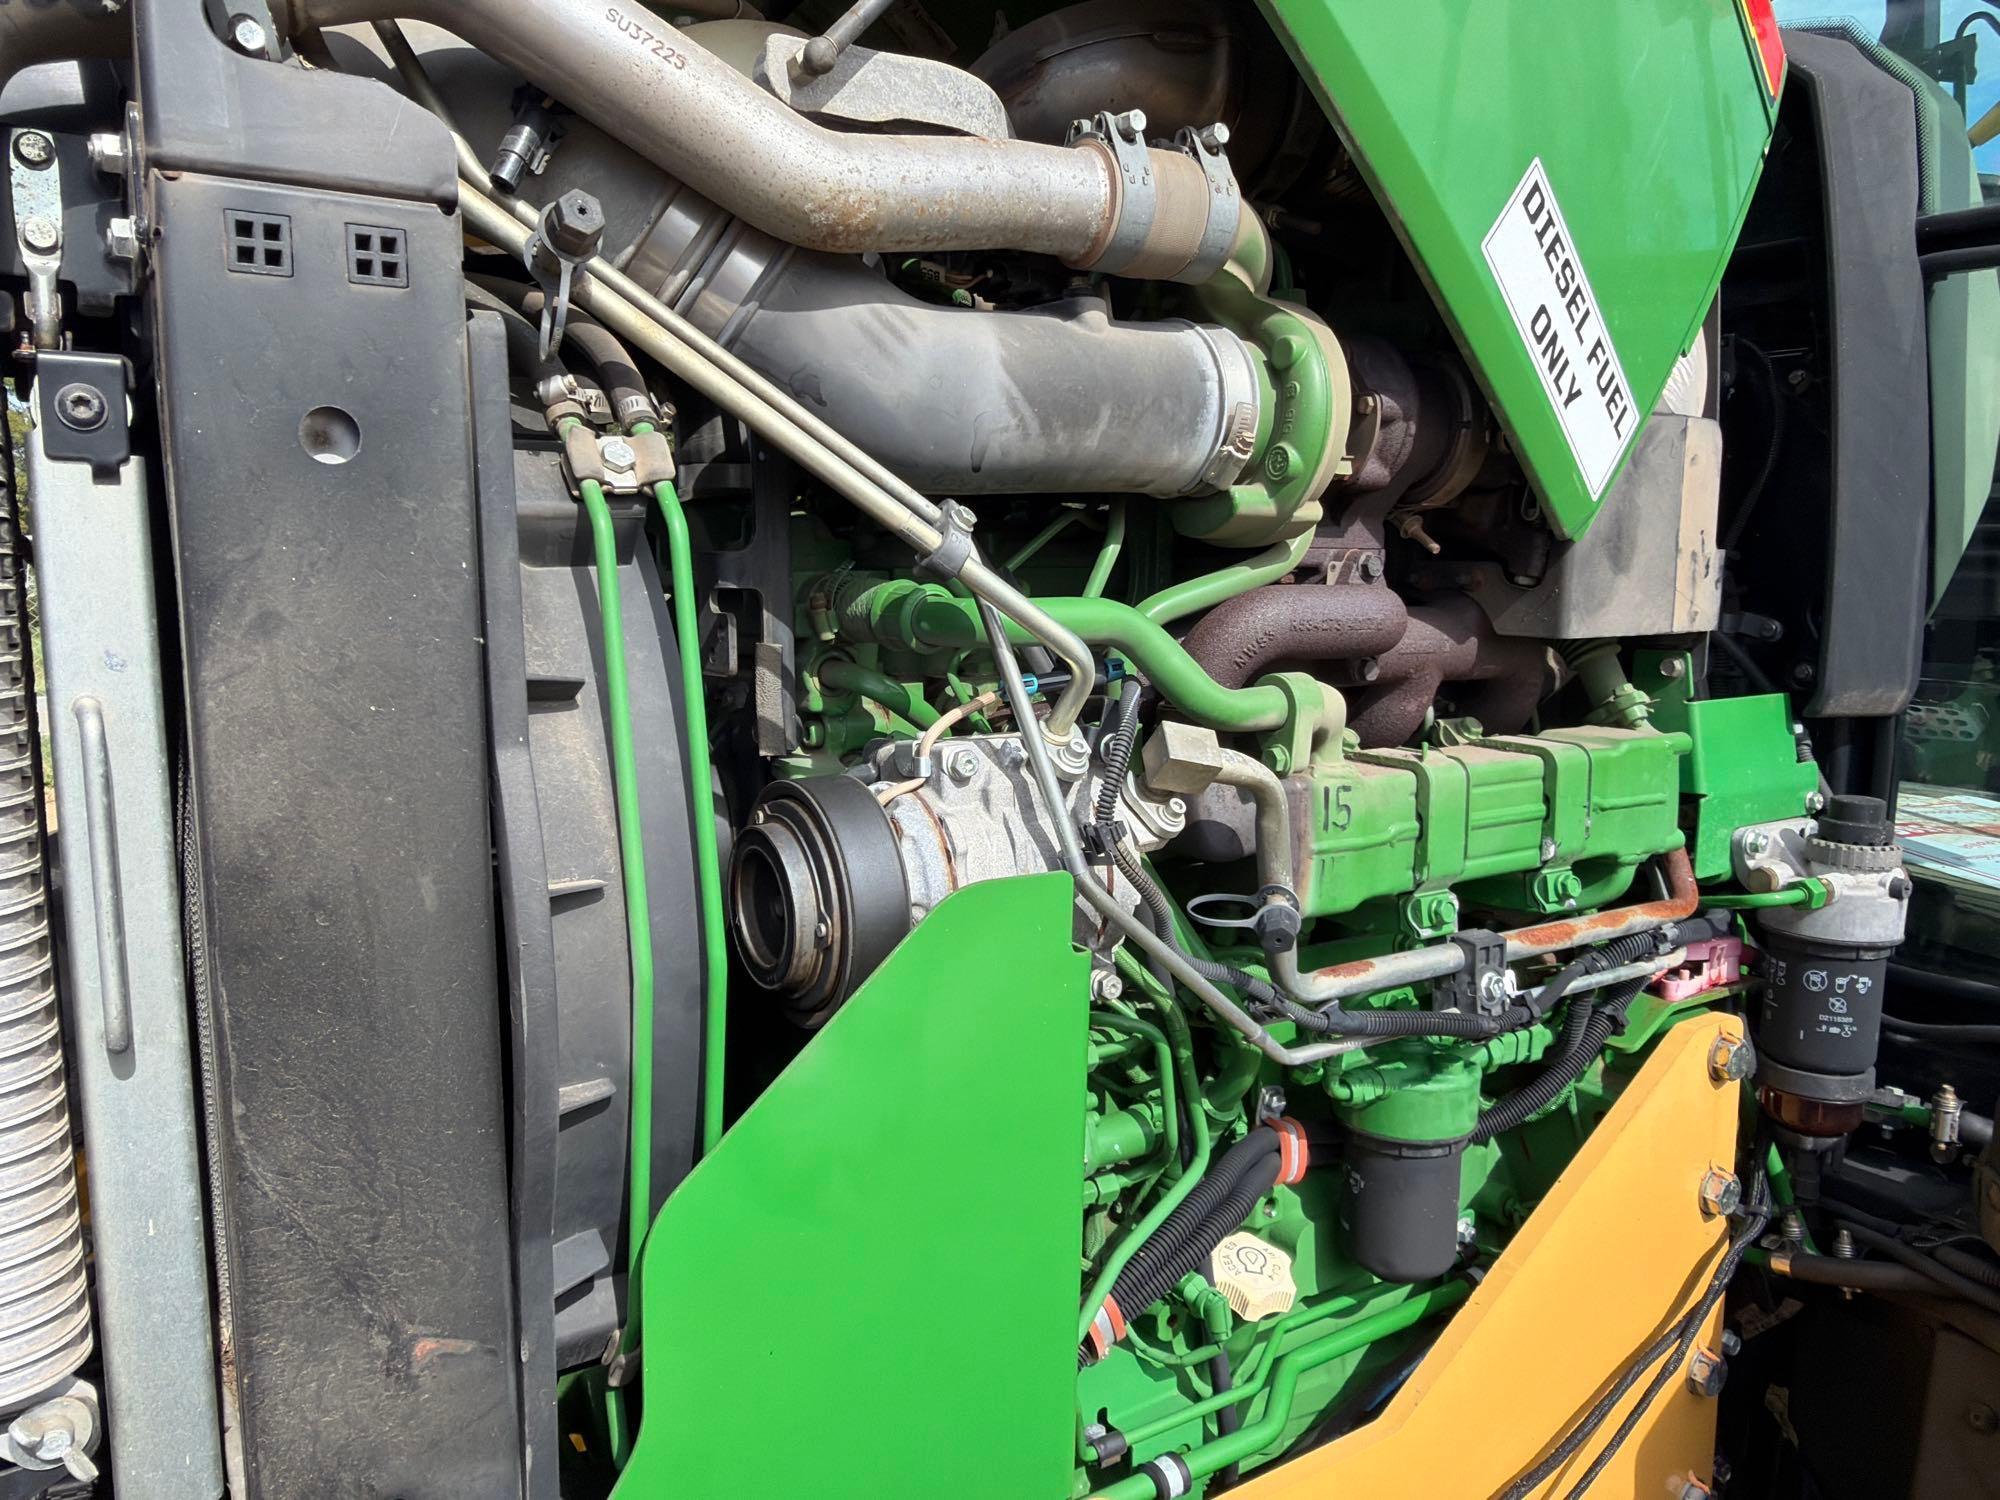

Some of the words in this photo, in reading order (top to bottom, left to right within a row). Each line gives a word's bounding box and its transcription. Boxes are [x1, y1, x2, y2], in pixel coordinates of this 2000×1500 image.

[605, 7, 688, 71] SU37225
[1522, 179, 1592, 346] DIESEL
[1587, 336, 1631, 440] FUEL
[1530, 303, 1583, 411] ONLY
[1322, 784, 1352, 833] 15
